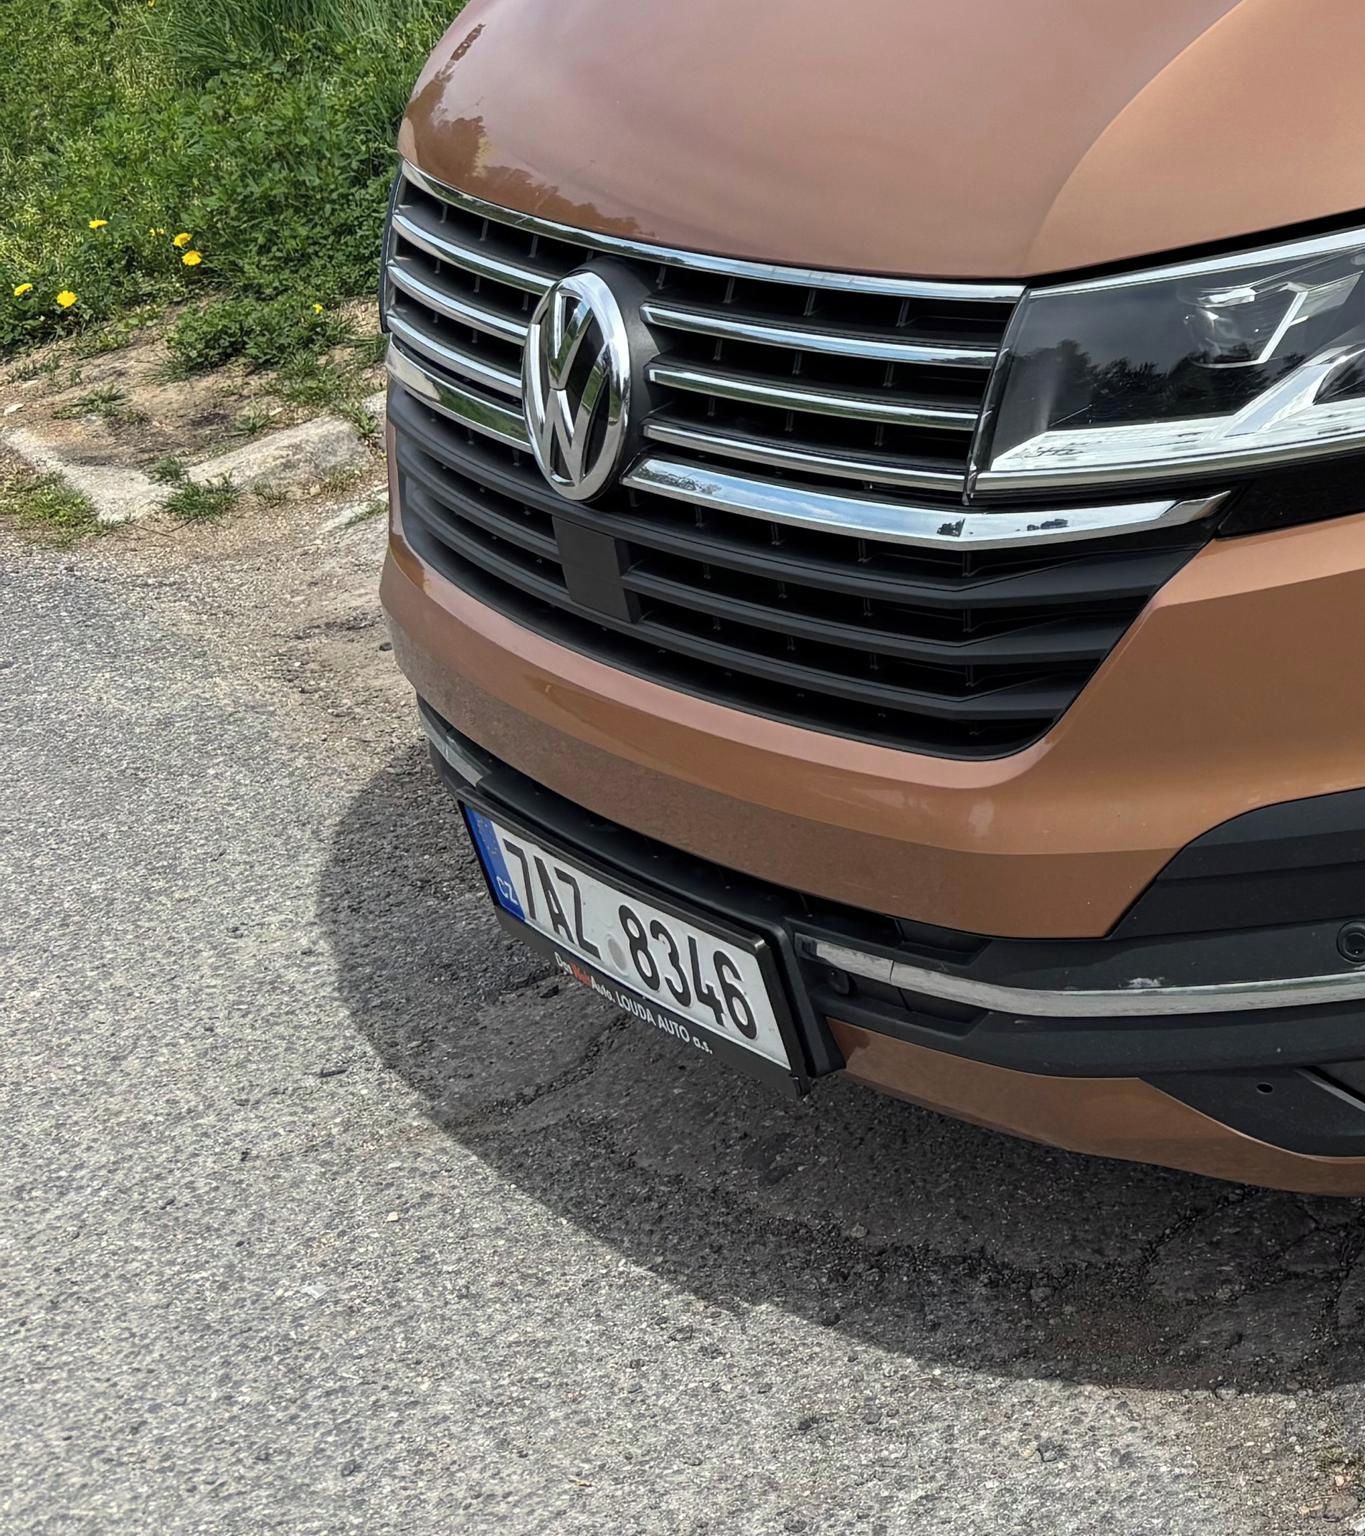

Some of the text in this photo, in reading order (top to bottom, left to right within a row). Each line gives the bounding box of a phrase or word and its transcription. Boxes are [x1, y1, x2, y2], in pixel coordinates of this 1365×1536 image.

[496, 875, 519, 906] CZ
[502, 837, 758, 1040] 7AZ 8346
[616, 991, 657, 1022] LOUDA
[657, 1010, 690, 1043] AUTO
